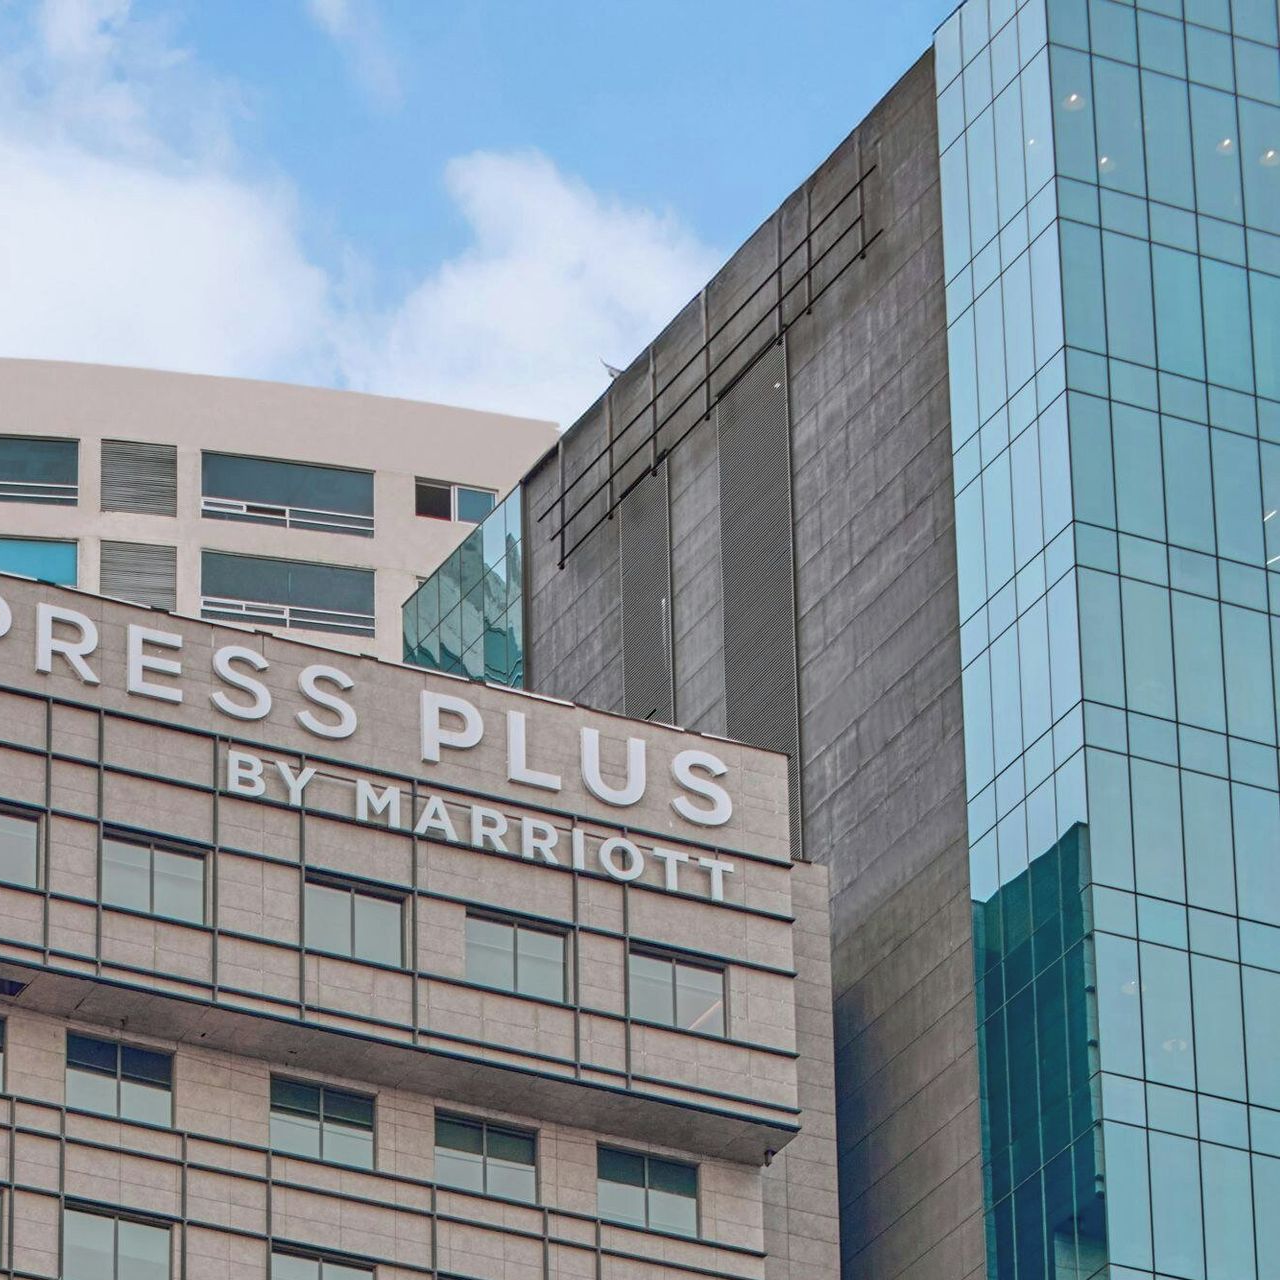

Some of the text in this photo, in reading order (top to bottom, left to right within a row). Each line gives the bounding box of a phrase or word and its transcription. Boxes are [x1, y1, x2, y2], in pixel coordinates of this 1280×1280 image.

[225, 749, 736, 903] BY MARRIOTT
[419, 689, 734, 827] PLUS
